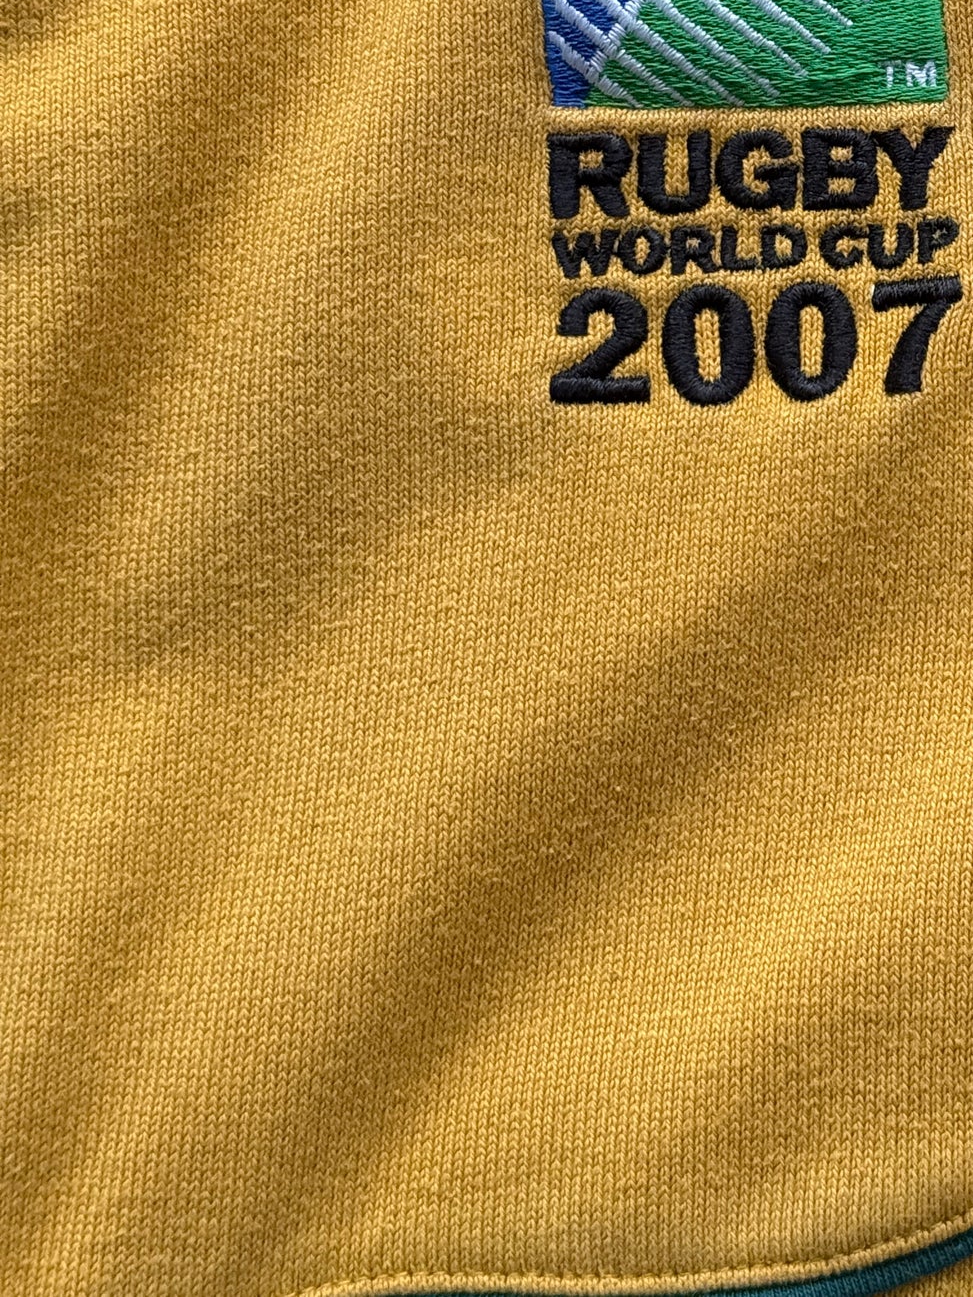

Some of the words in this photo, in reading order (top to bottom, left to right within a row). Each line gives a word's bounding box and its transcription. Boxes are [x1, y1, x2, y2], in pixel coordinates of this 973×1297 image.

[879, 60, 937, 88] TM
[546, 125, 956, 220] RUGBY
[552, 224, 808, 279] WORLD
[819, 216, 960, 271] CUP
[548, 275, 964, 406] 2007
